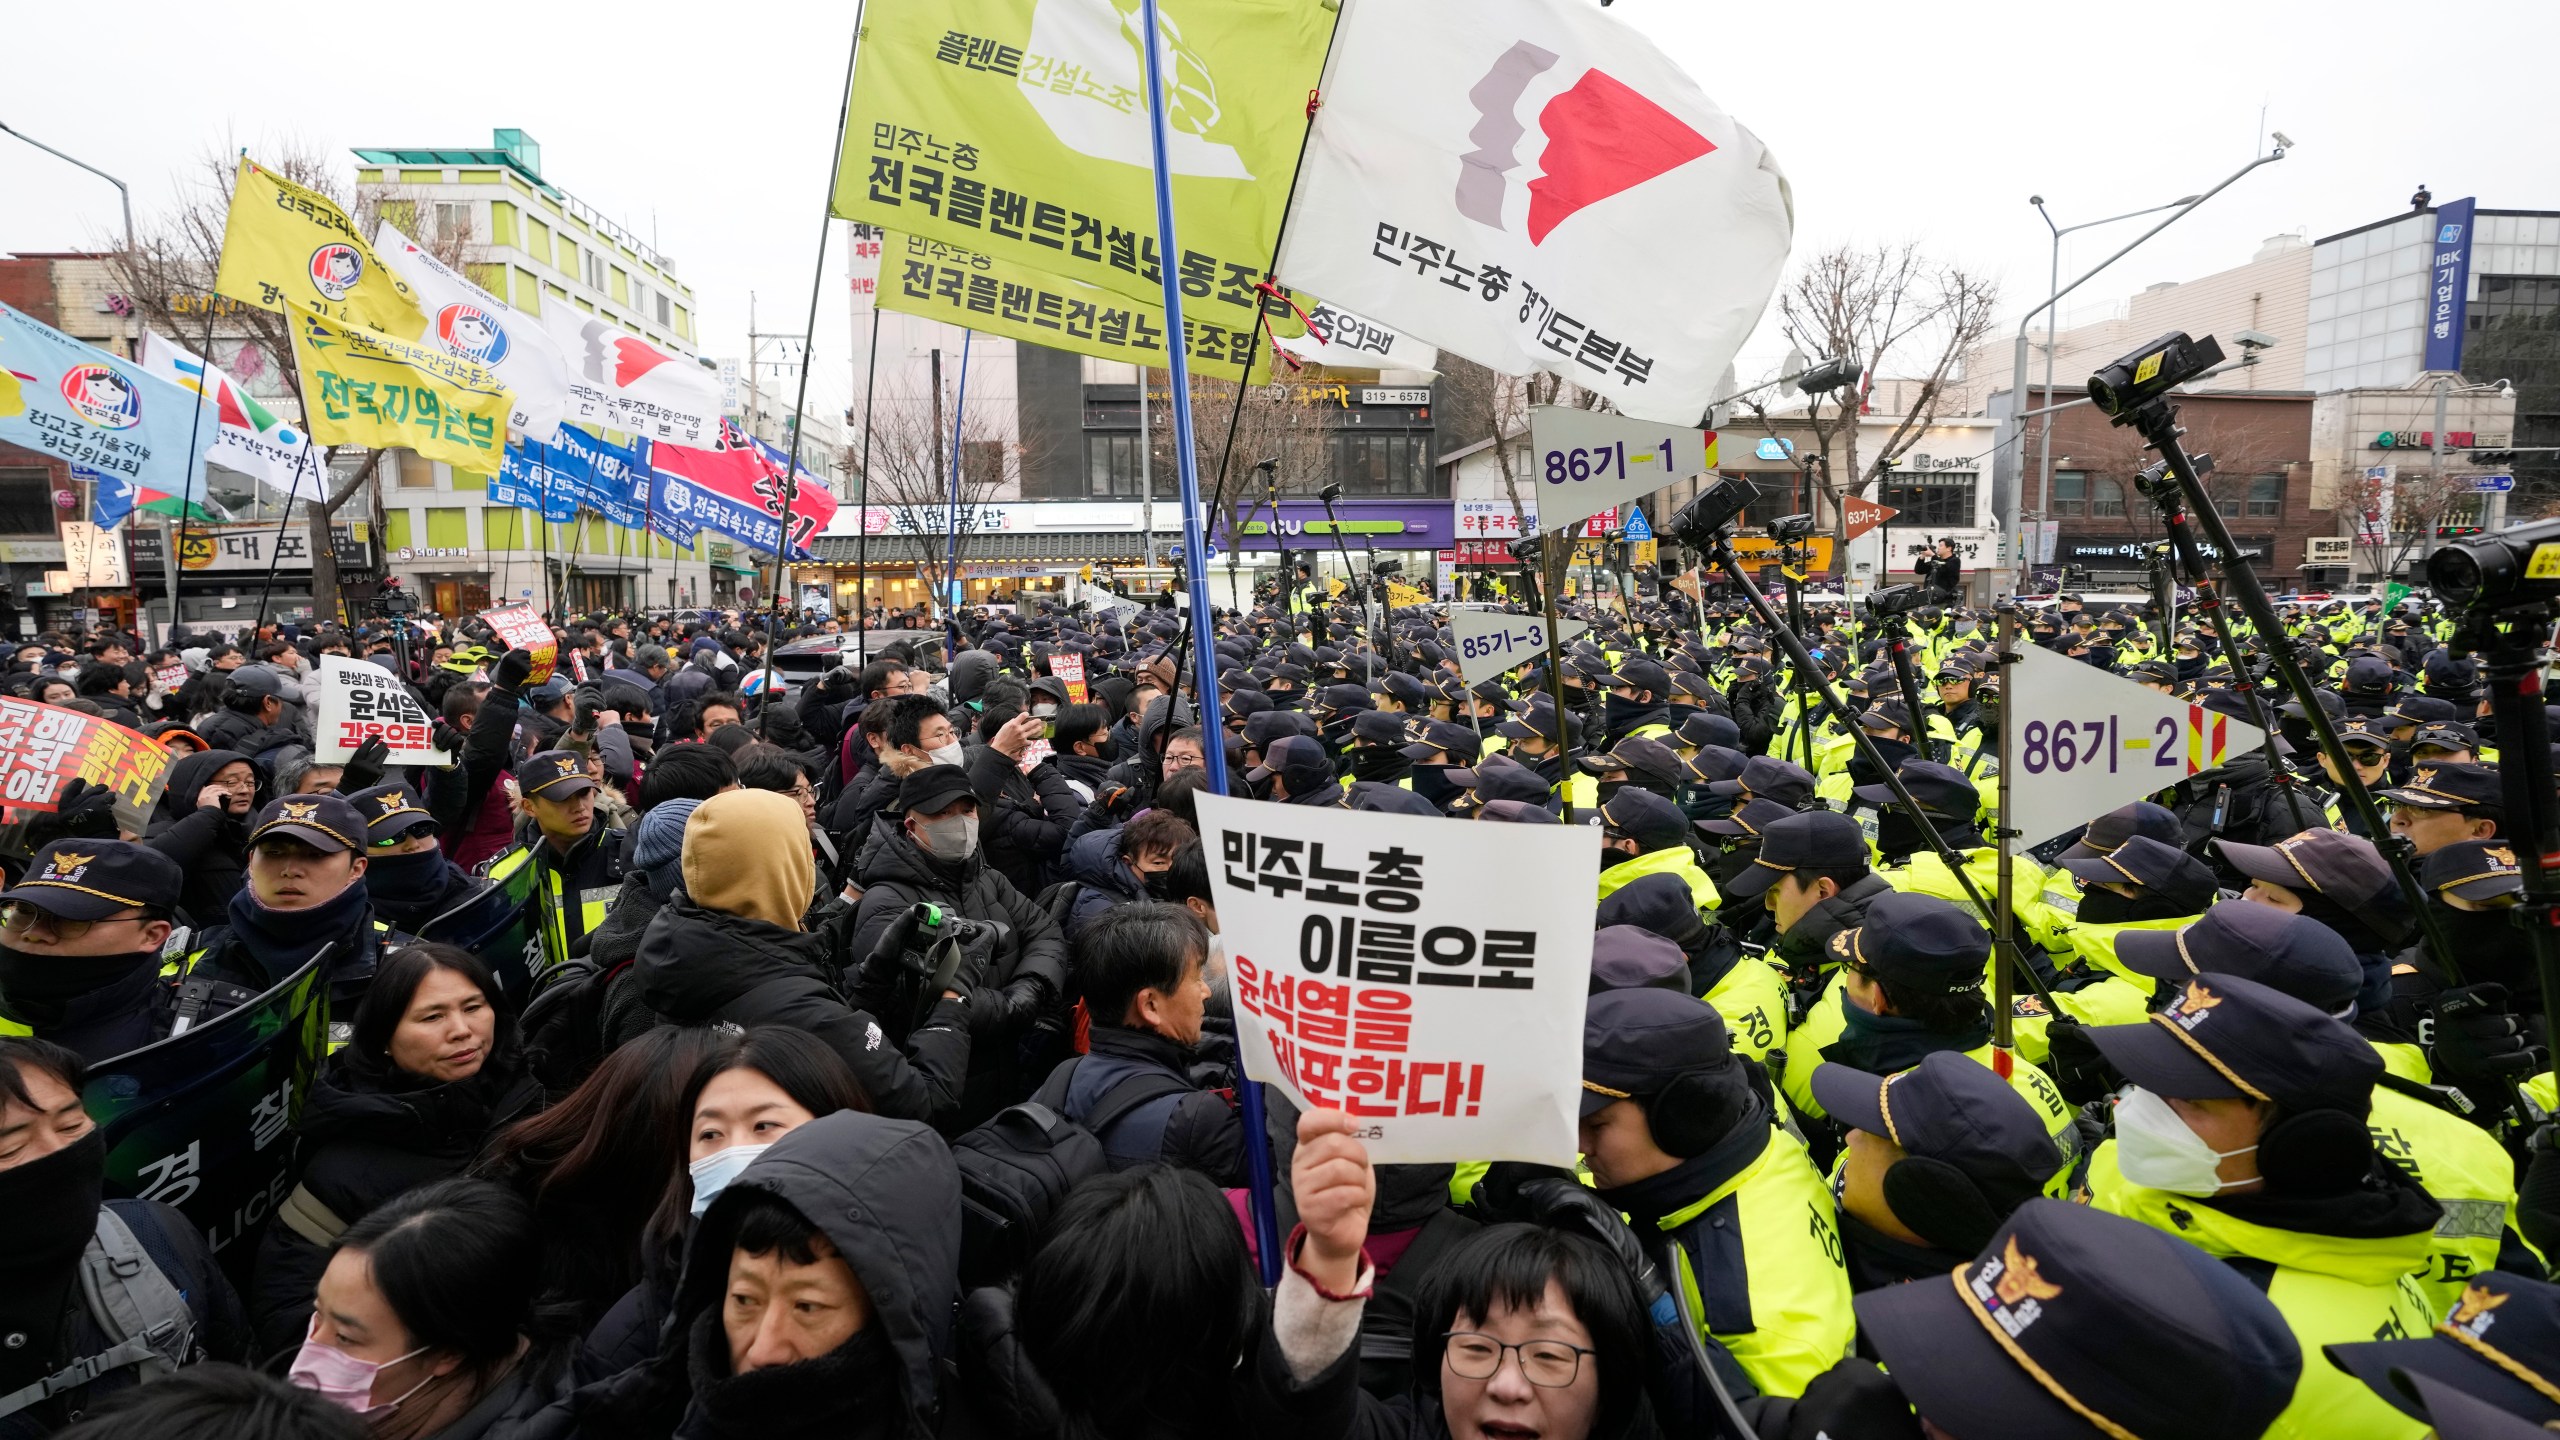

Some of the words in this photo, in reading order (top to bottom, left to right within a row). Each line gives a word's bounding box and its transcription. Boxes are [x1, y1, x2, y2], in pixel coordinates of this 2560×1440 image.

[873, 121, 980, 172] 민주노총
[2436, 249, 2461, 267] IBK
[1373, 221, 1512, 302] 민주노총
[1519, 280, 1655, 387] 경기도본부
[2433, 267, 2455, 339] 기업은행
[40, 431, 141, 477] 청년위원회
[1545, 438, 1673, 485] 86기-1
[1271, 519, 1300, 536] CU
[1848, 509, 1880, 524] 63기-2
[1462, 624, 1543, 659] 85기-3
[339, 670, 372, 687] 망상과
[350, 689, 425, 724] 윤석열
[2023, 715, 2178, 774] 86기-2
[1222, 829, 1423, 914] 민주노총
[1300, 914, 1537, 990] 이름으로
[1236, 955, 1413, 1052] 윤석열을
[1267, 1028, 1485, 1118] 체포한다!
